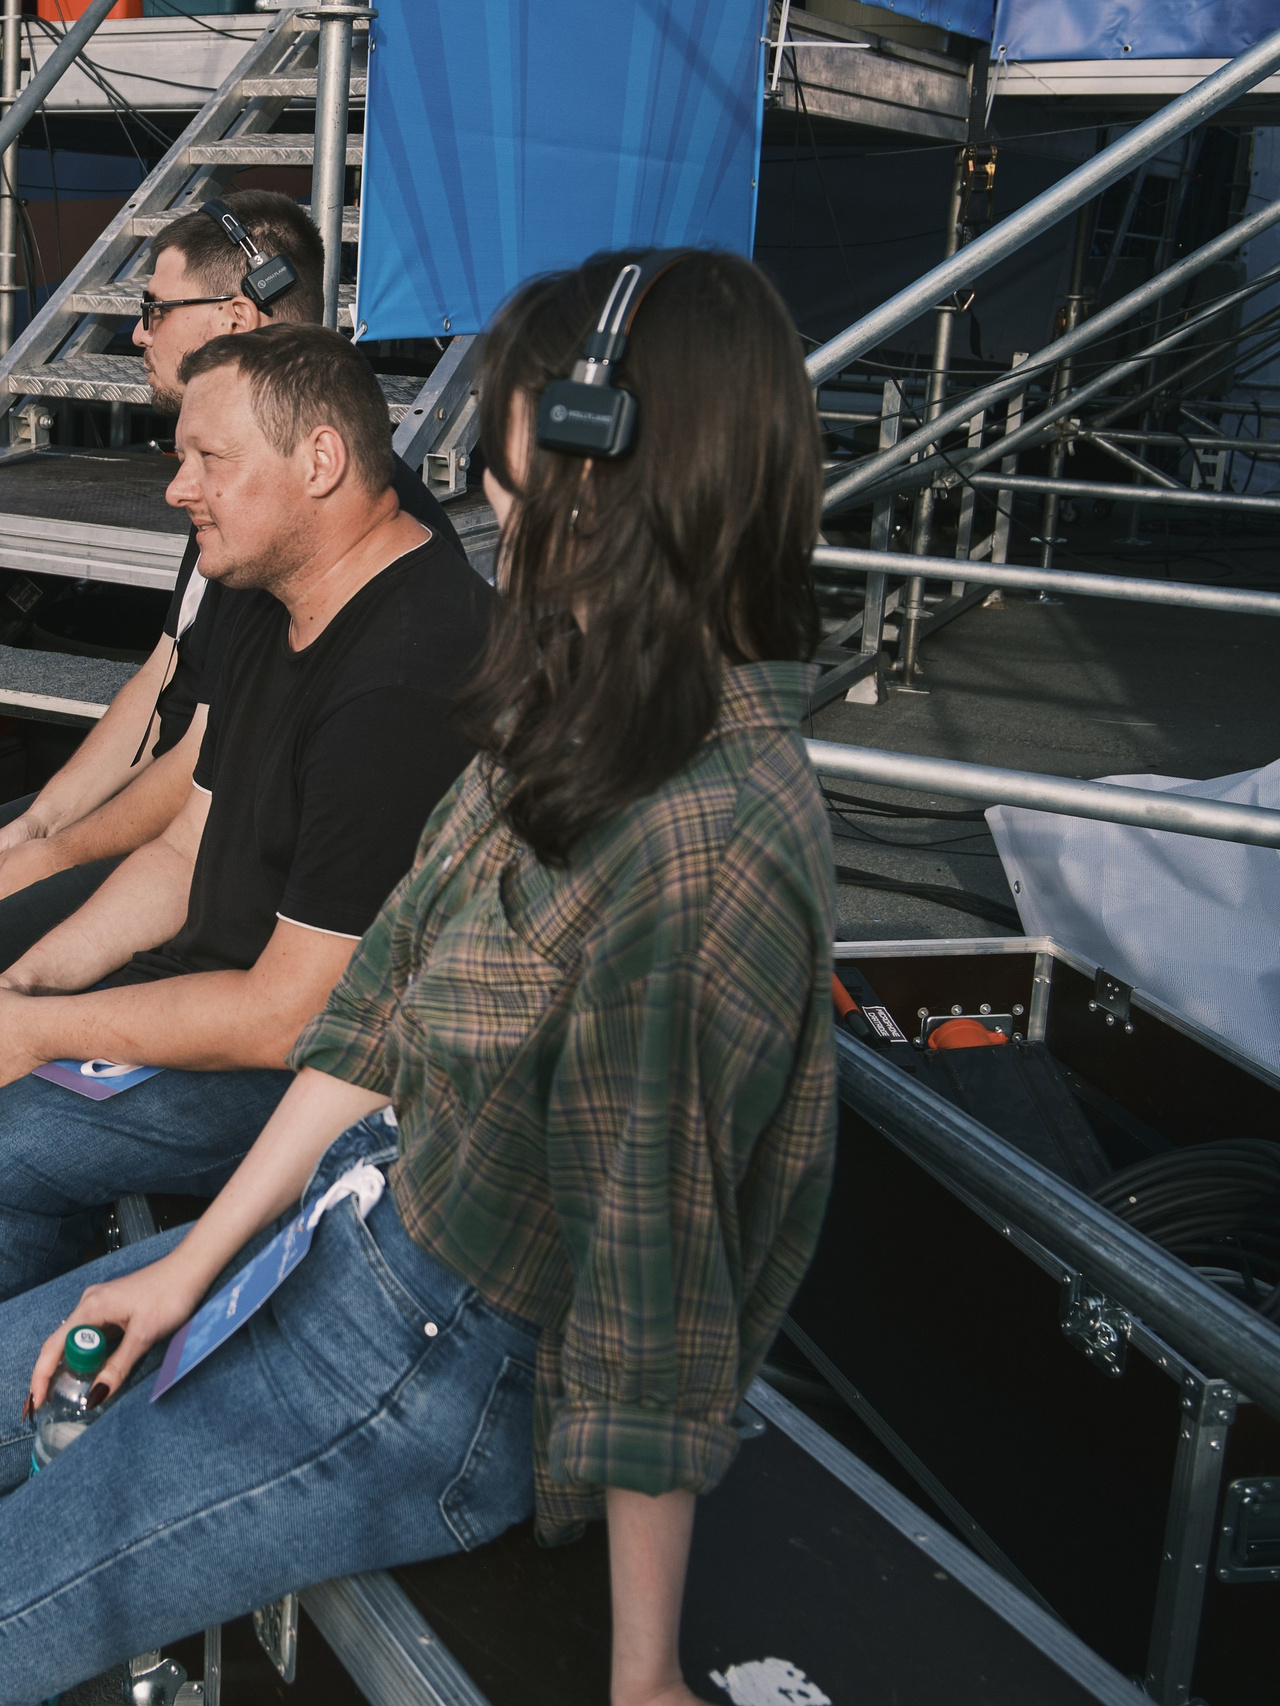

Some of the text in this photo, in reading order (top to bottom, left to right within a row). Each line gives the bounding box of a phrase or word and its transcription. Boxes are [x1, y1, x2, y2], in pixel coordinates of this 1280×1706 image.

[254, 255, 264, 265] 3
[584, 363, 598, 385] 1
[876, 1009, 901, 1038] MICROPHONE
